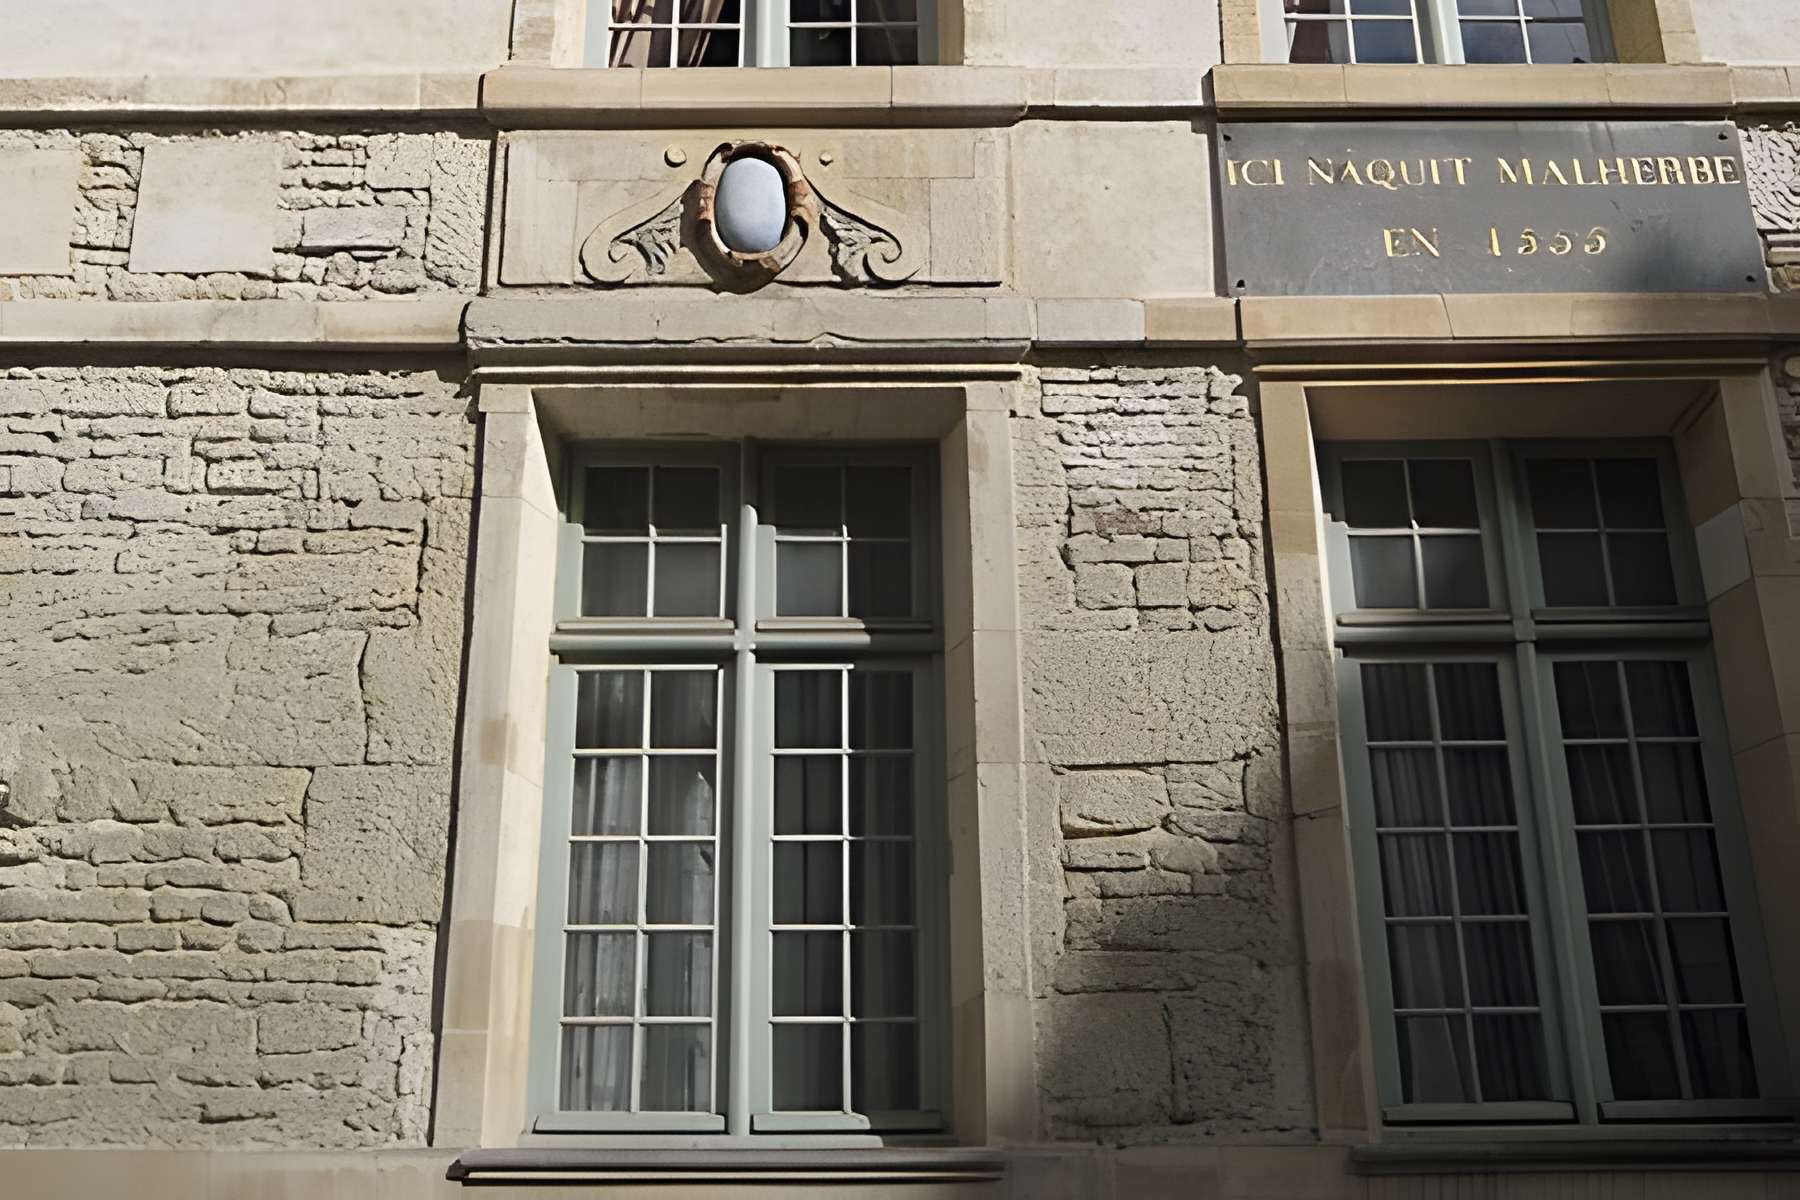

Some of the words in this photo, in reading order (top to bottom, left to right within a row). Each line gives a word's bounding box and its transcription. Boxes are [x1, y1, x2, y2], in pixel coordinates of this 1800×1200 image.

[1227, 158, 1285, 186] ICI
[1497, 156, 1742, 185] MALHERBE
[1383, 228, 1440, 257] EN
